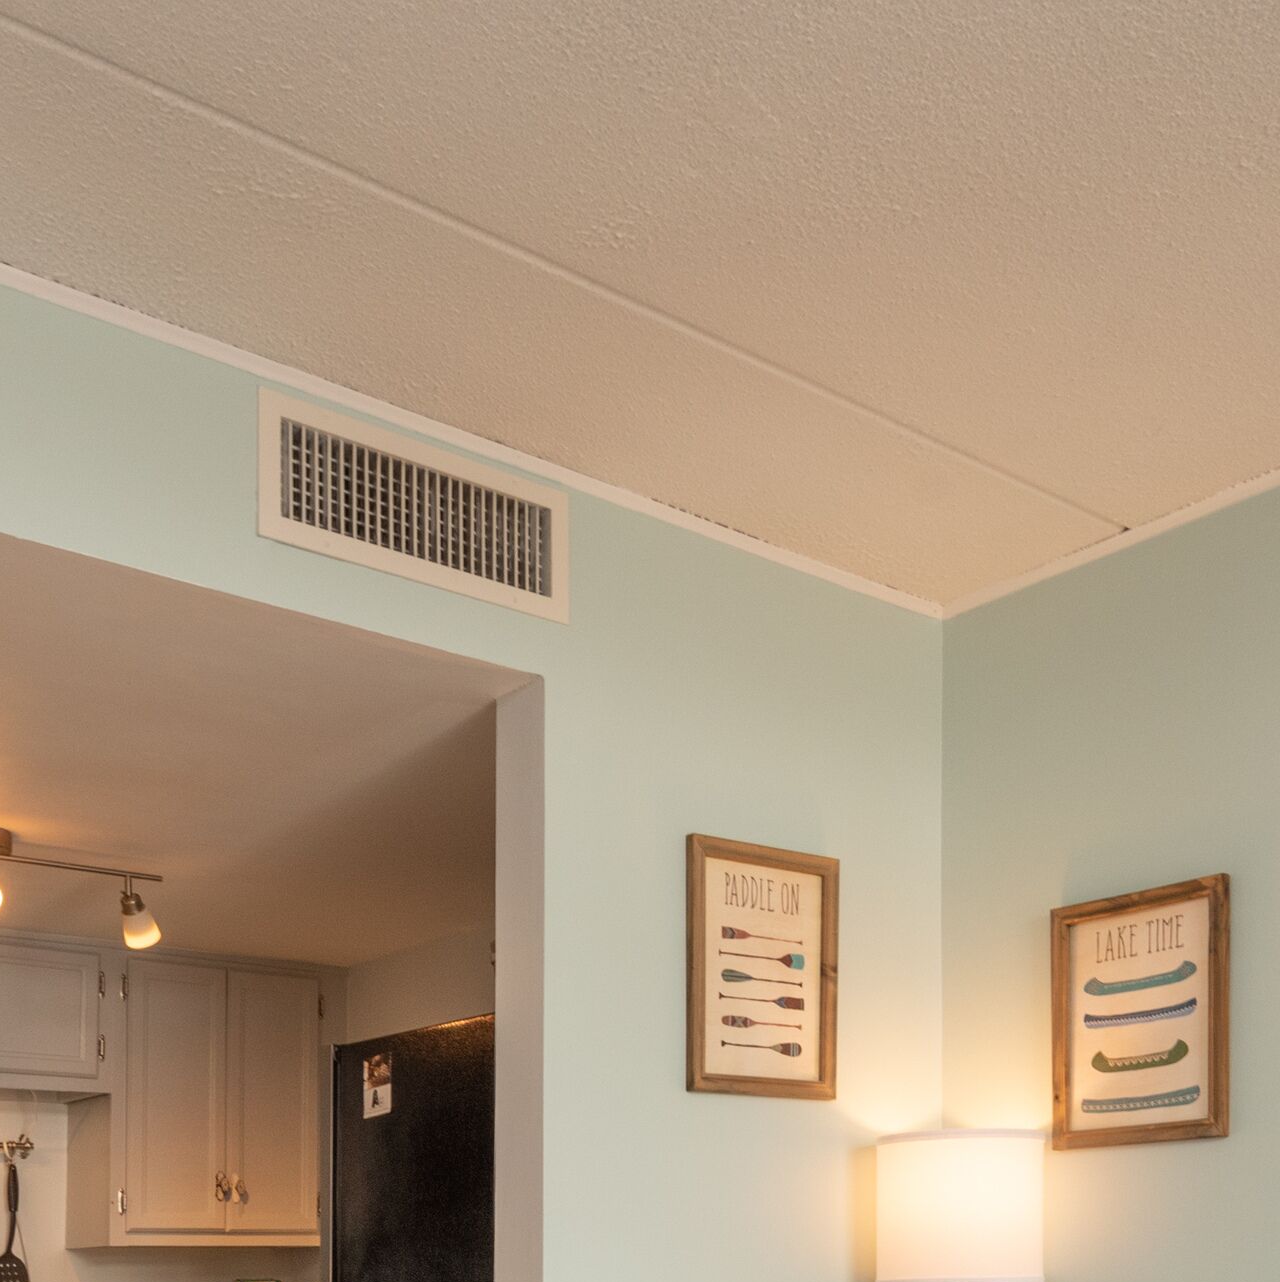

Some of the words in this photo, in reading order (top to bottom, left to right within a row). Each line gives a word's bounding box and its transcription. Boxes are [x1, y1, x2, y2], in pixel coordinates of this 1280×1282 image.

[724, 872, 774, 912] PADDLE
[781, 882, 800, 915] ON
[1096, 923, 1138, 963] LAKE
[1146, 914, 1184, 954] TIME
